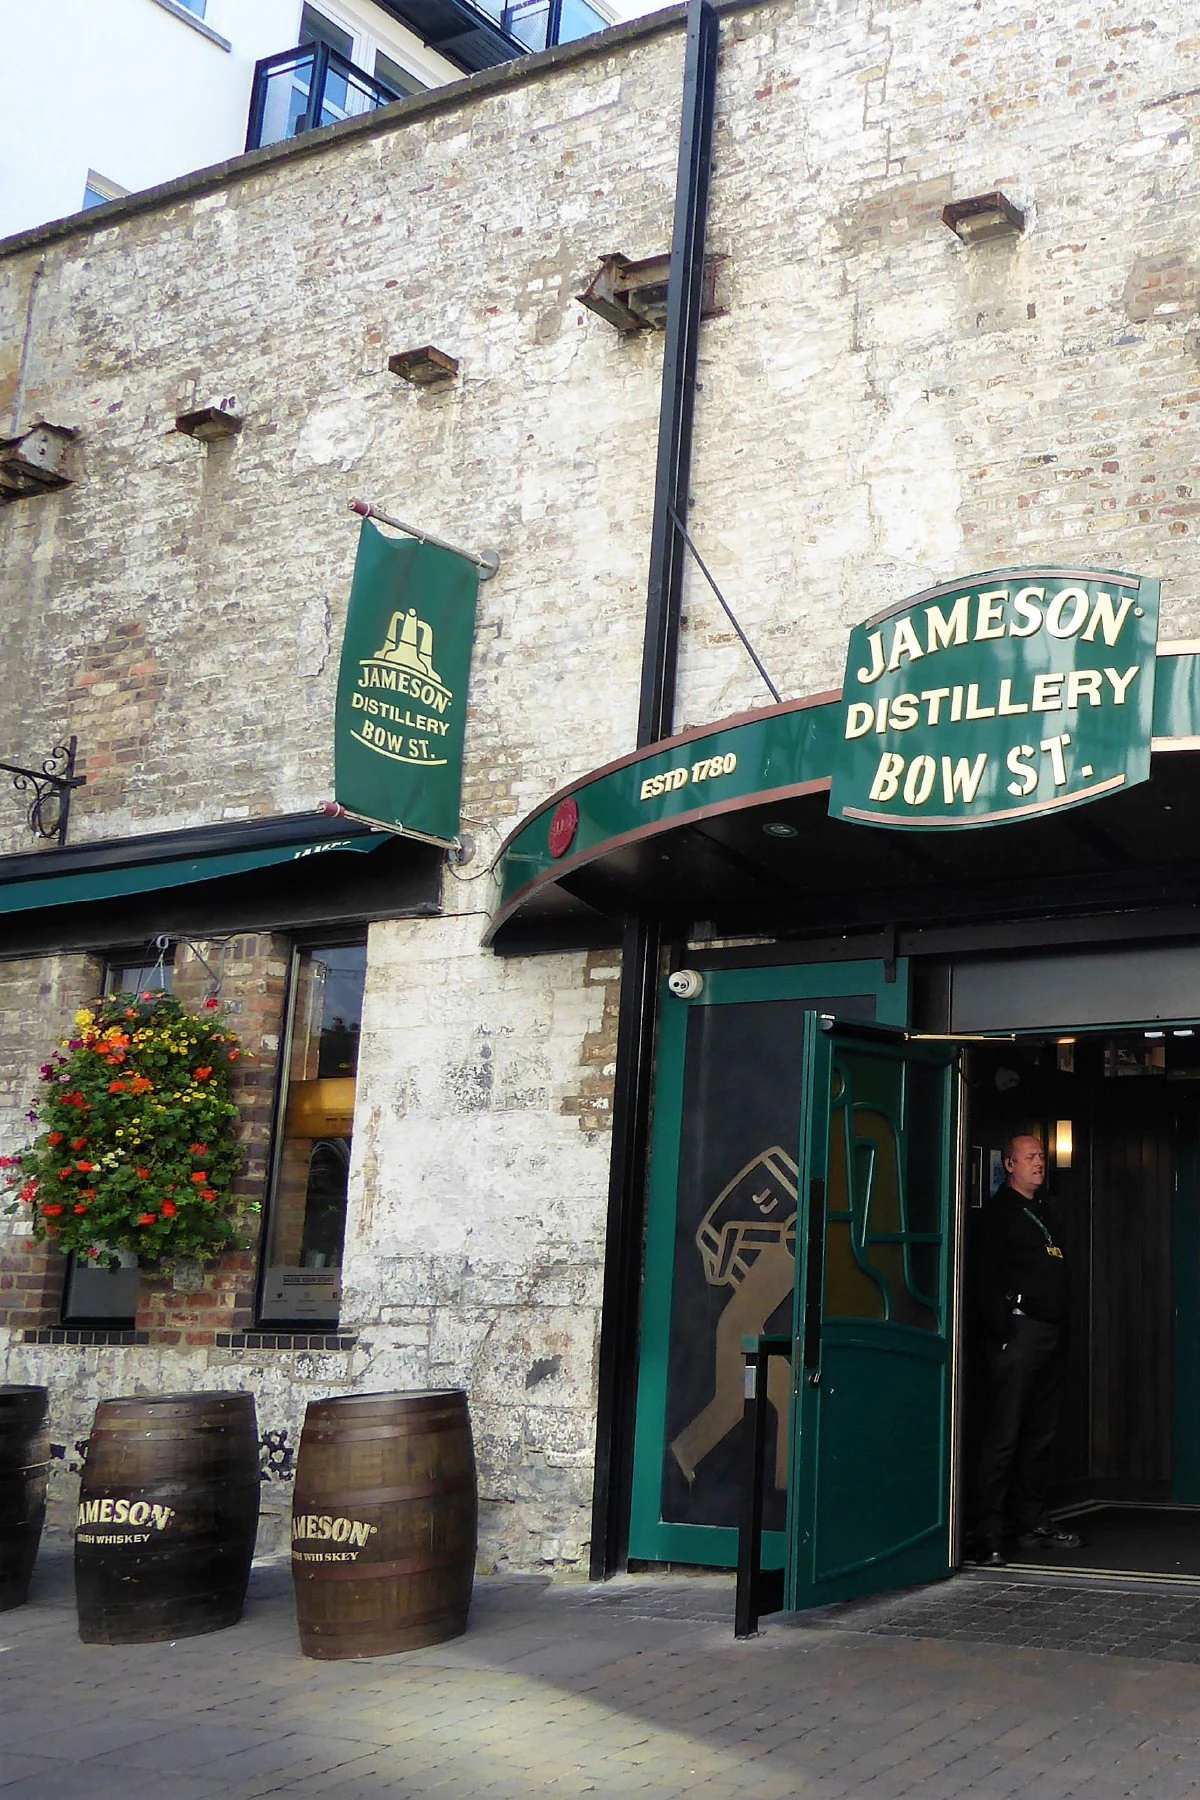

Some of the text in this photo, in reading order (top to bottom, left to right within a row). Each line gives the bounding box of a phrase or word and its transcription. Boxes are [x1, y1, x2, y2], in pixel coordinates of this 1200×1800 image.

[857, 586, 1135, 684] JAMESON
[357, 666, 448, 714] JAMESON
[845, 665, 1140, 740] DISTILLERY
[351, 692, 450, 737] DISTILLERY
[361, 719, 436, 759] BOW ST.
[640, 752, 737, 801] ESTD 1780
[868, 733, 1094, 806] BOW ST.
[78, 1498, 172, 1531] AMESON
[291, 1514, 372, 1547] AMESON
[96, 1533, 150, 1545] WHISKEY
